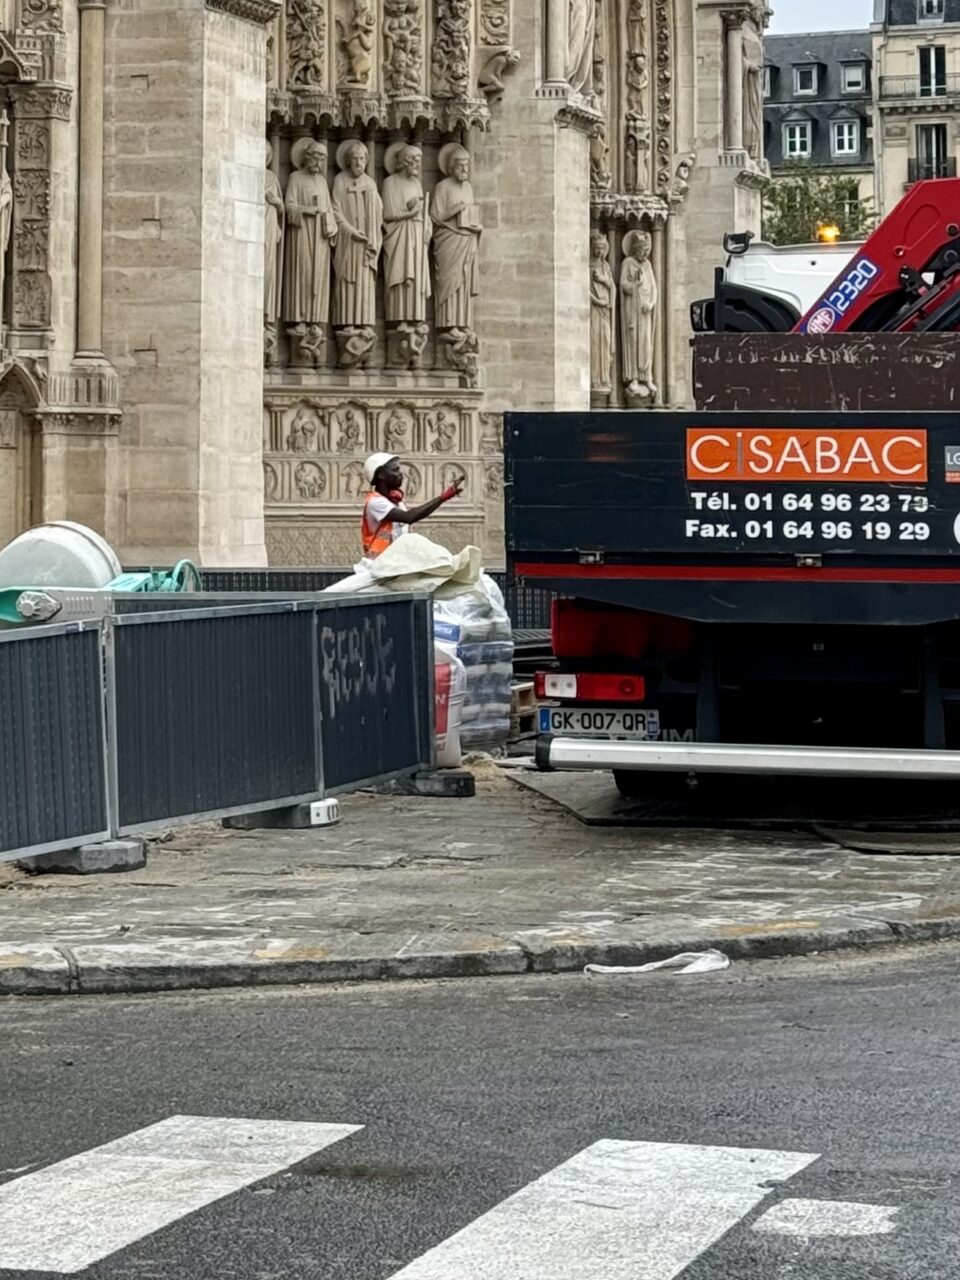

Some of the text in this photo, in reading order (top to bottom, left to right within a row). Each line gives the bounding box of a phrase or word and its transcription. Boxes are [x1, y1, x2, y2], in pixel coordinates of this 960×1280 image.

[829, 259, 877, 312] 2320
[690, 491, 737, 511] Tél.
[744, 492, 773, 511] 01
[782, 493, 813, 511] 64
[821, 493, 852, 512] 96
[859, 494, 890, 512] 23
[685, 519, 930, 540] Fax. 01 64 96 19 29
